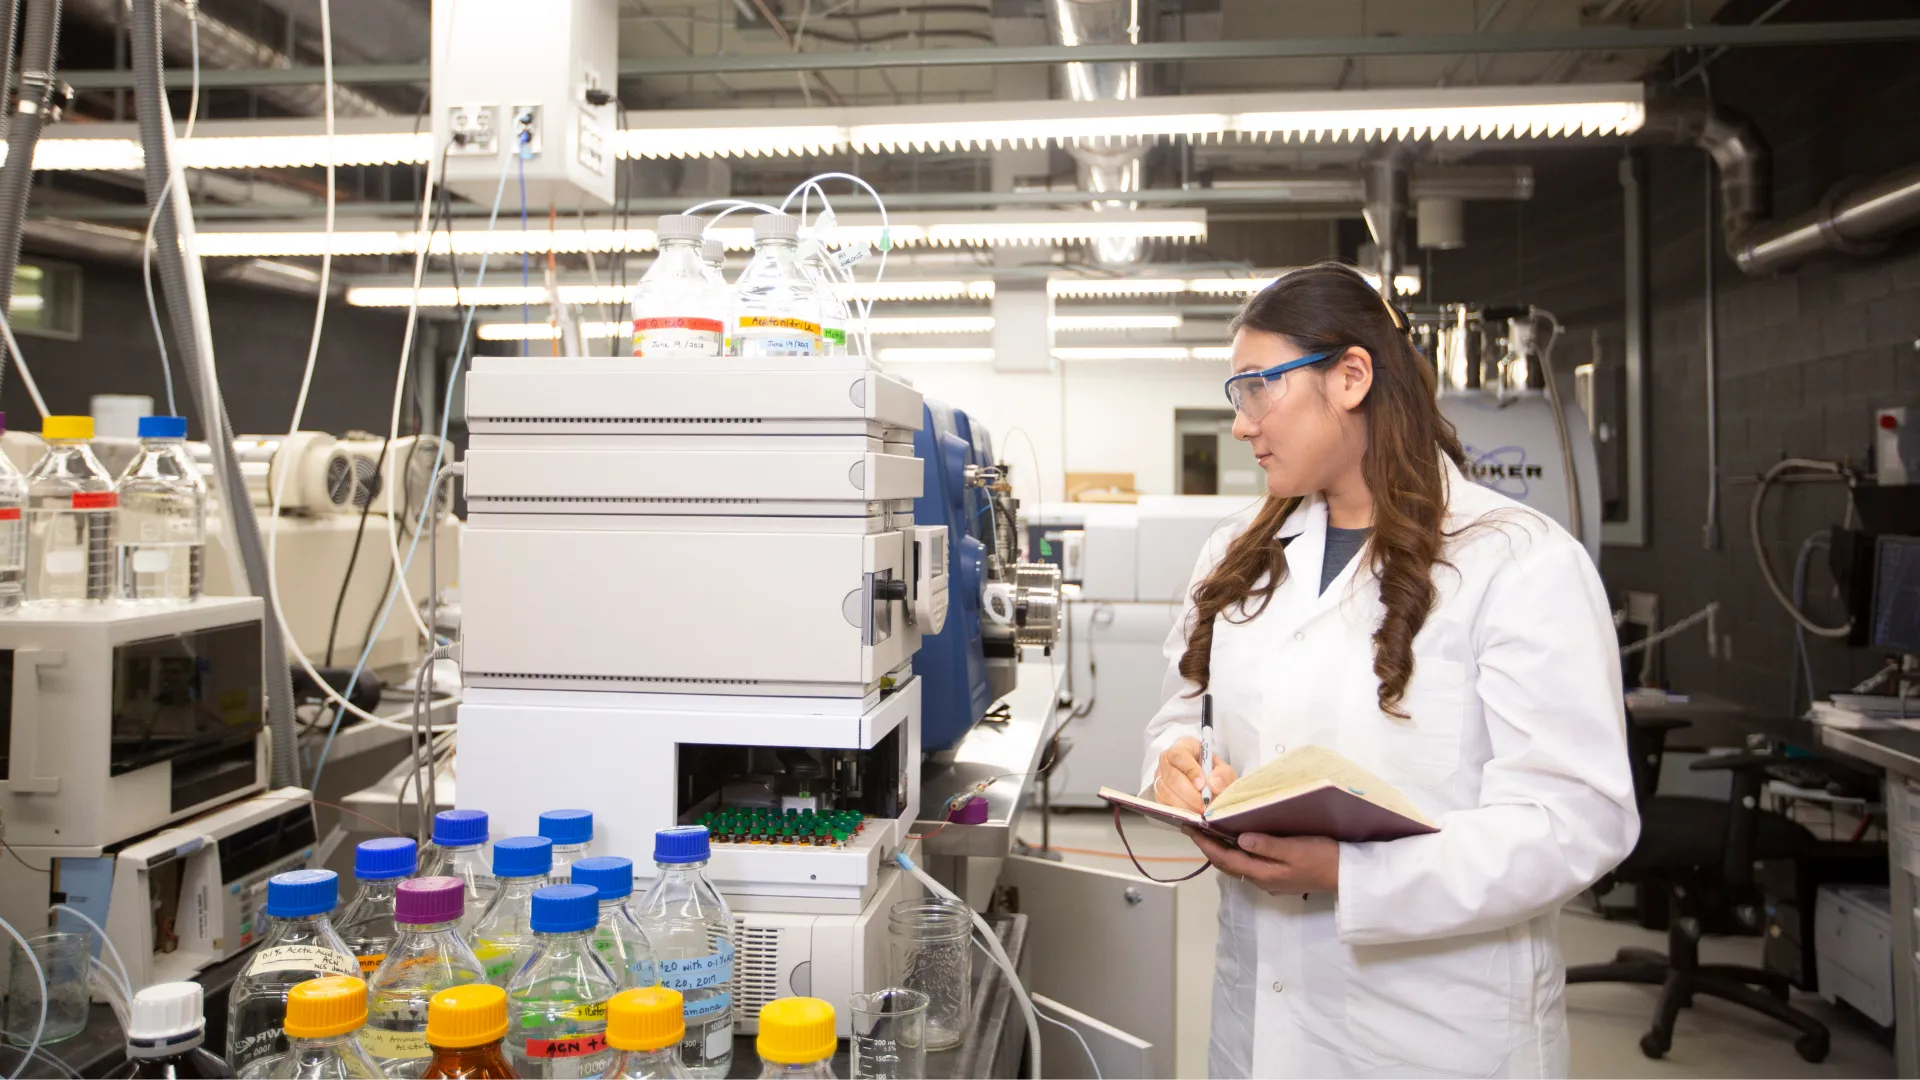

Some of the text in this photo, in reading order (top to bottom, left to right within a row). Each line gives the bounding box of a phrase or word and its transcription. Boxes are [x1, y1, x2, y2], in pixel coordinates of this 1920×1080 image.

[1470, 464, 1544, 480] UKER
[682, 959, 703, 972] with
[696, 973, 717, 987] 2017
[682, 1002, 722, 1017] amanna
[683, 1039, 697, 1048] 300
